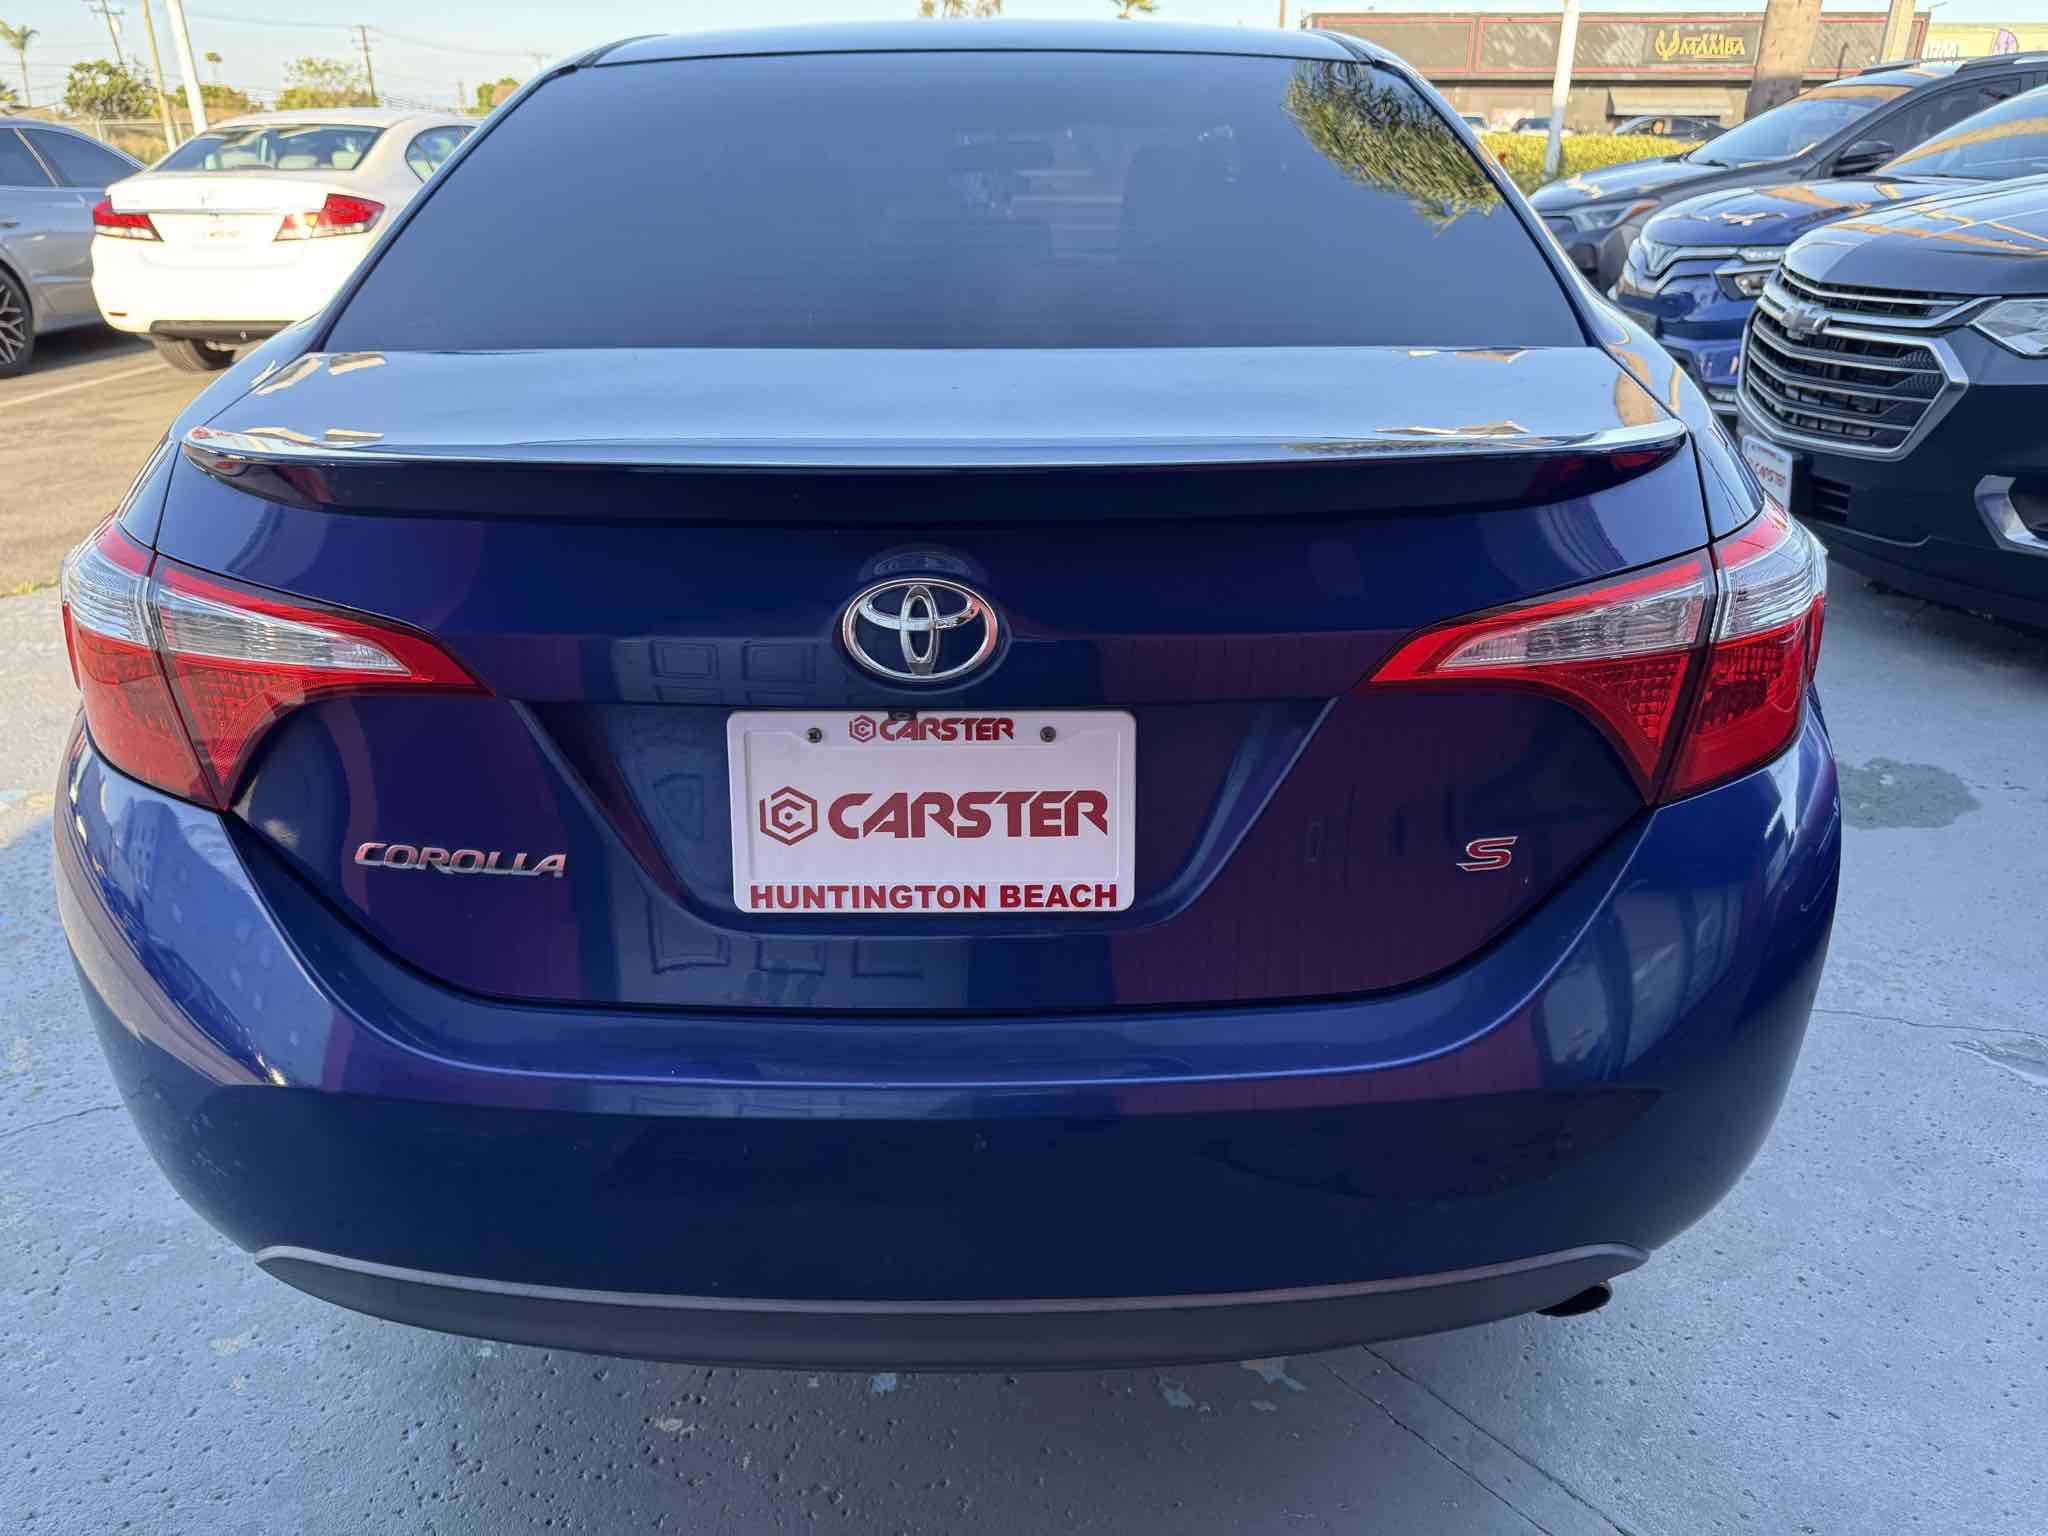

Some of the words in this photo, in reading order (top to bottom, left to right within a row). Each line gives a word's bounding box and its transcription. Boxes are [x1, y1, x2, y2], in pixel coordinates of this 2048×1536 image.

[879, 717, 1015, 742] CARSTER
[828, 789, 1109, 840] CARSTER
[354, 842, 567, 878] COROLLA
[1455, 836, 1518, 871] S
[750, 885, 987, 909] HUNTINGTON
[1000, 884, 1117, 908] BEACH
